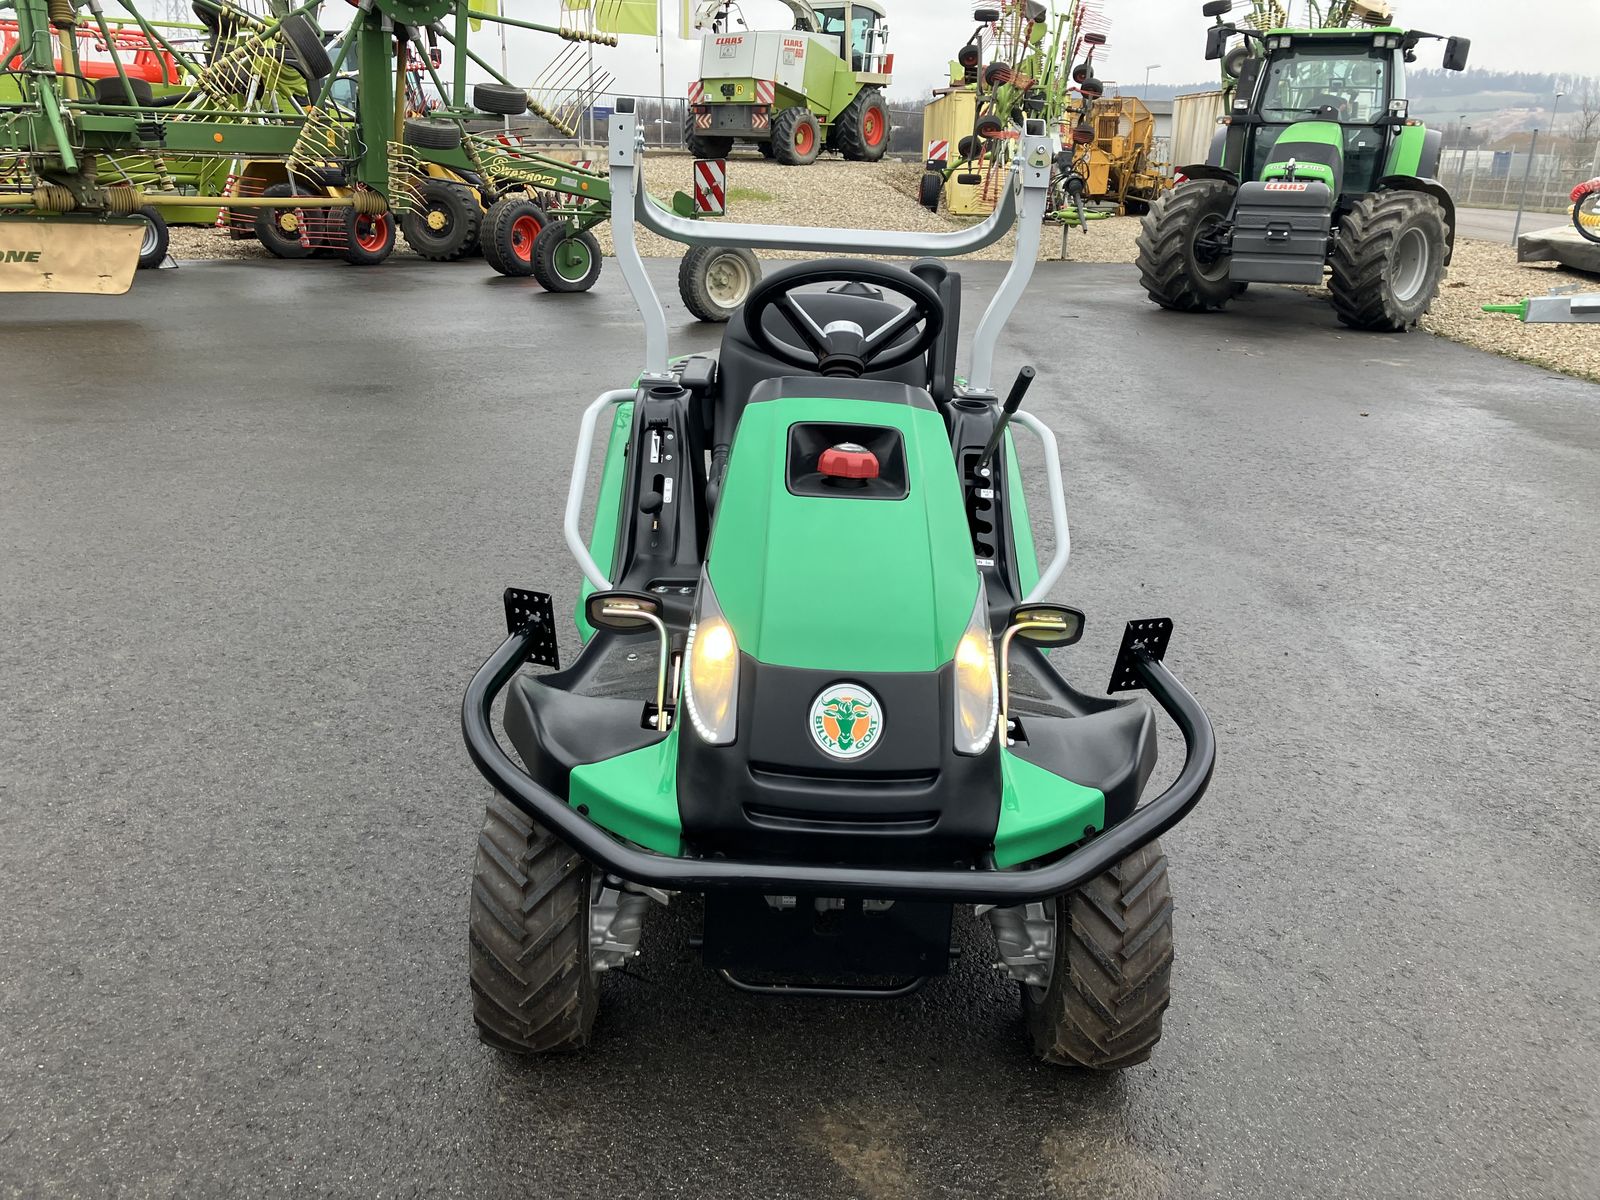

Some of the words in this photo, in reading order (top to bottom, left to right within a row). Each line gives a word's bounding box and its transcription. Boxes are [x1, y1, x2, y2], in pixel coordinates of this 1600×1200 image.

[716, 37, 743, 45] CLAAS
[783, 39, 802, 48] CLAAS
[815, 715, 836, 747] BILLY
[855, 718, 877, 749] GOAT
